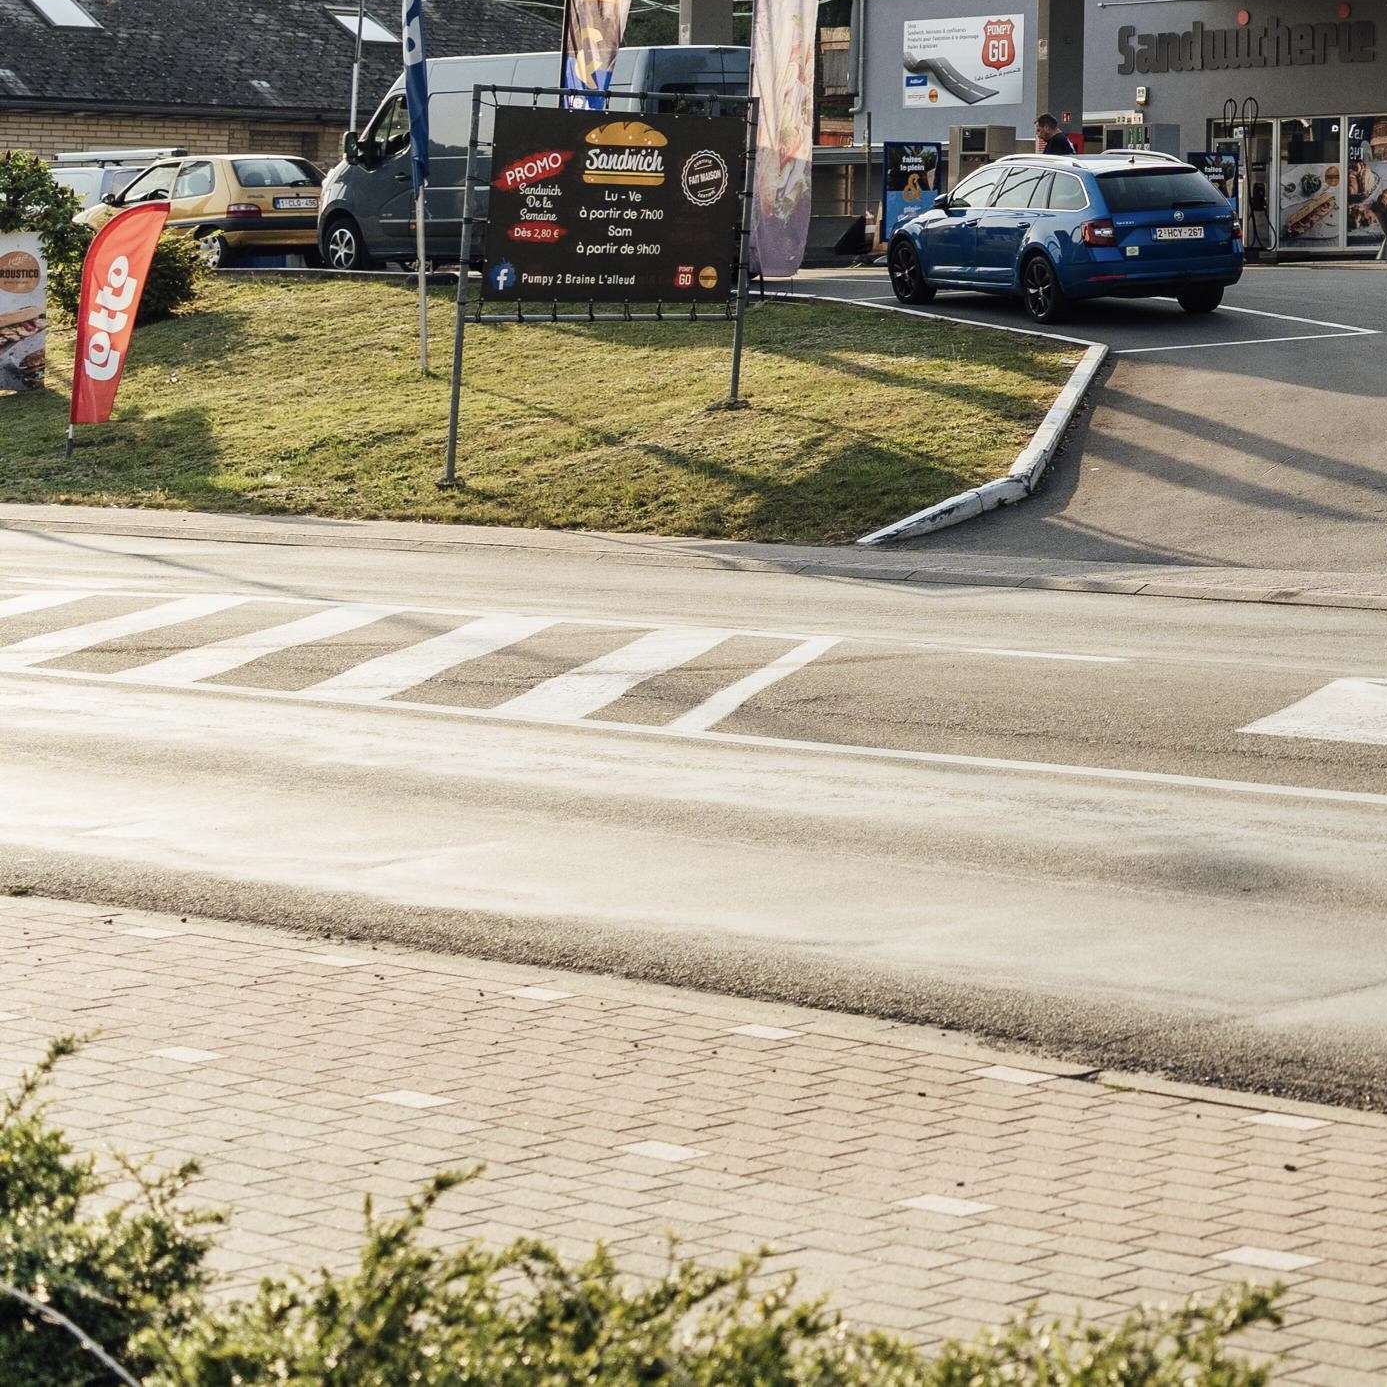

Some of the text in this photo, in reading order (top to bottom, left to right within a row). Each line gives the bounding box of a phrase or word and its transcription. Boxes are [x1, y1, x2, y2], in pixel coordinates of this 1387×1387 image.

[987, 24, 1012, 35] PUMPY
[1117, 3, 1376, 75] Sandwicherie
[989, 39, 1008, 62] GO
[585, 148, 664, 172] Sandwich
[902, 155, 923, 163] faites
[505, 152, 562, 185] PROMO
[907, 164, 925, 172] plein
[518, 182, 562, 198] Sandwich
[604, 190, 618, 202] Lu
[628, 190, 642, 202] Ve
[526, 195, 553, 209] De la
[519, 209, 558, 222] Semaine
[579, 206, 664, 223] à partir de 7h00
[514, 226, 560, 240] Dès 2,80 €
[607, 225, 633, 237] Sam
[576, 241, 661, 258] à partir de 9h00
[521, 272, 636, 286] Pumpy 2 Braine L'alleud
[679, 273, 692, 285] GO
